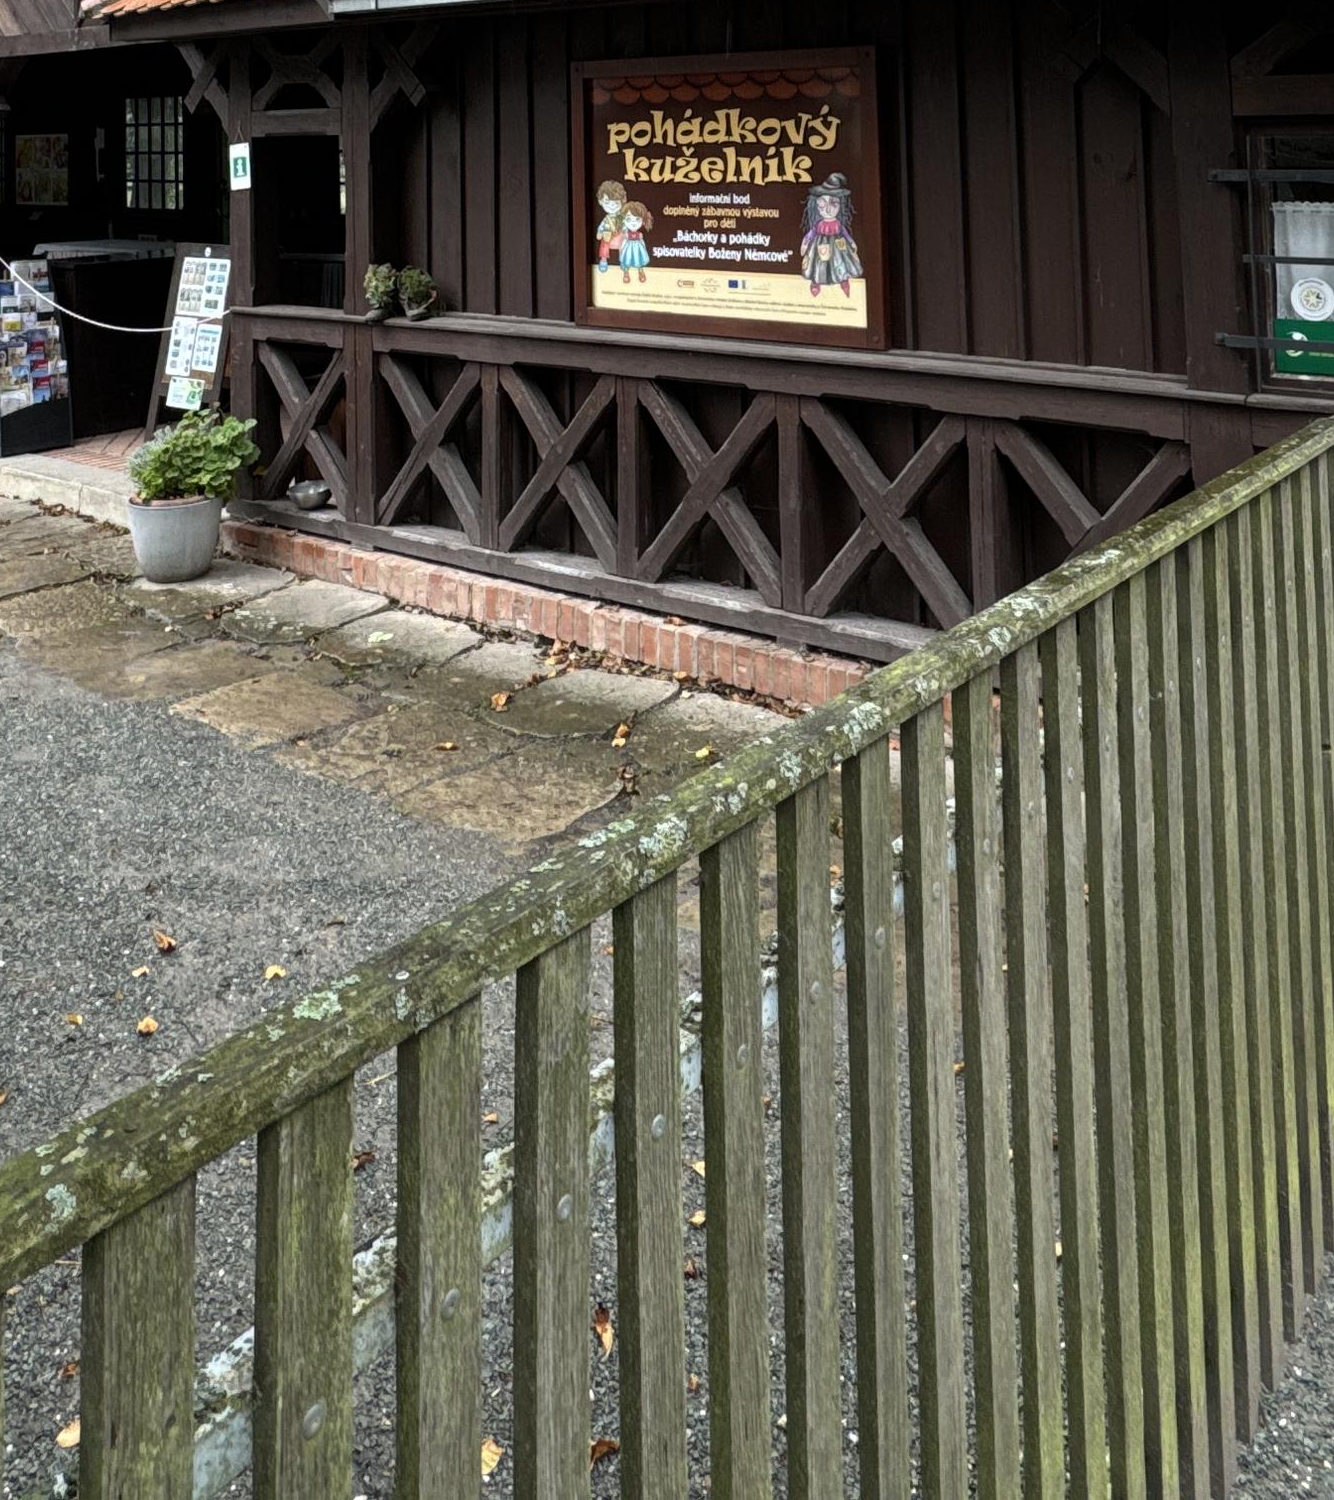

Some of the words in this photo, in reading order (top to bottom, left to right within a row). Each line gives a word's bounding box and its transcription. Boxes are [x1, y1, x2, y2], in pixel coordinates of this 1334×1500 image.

[607, 104, 841, 154] pohádkový
[624, 146, 813, 185] kuželník
[689, 193, 731, 204] informační
[733, 193, 750, 204] bod
[663, 205, 699, 217] doplněný
[702, 206, 741, 217] zábavnou
[742, 207, 779, 218] výstavou
[703, 219, 718, 229] pro
[720, 234, 727, 243] a
[729, 232, 771, 246] pohádky
[653, 246, 706, 260] spisovatelky
[708, 247, 742, 261] Boženy
